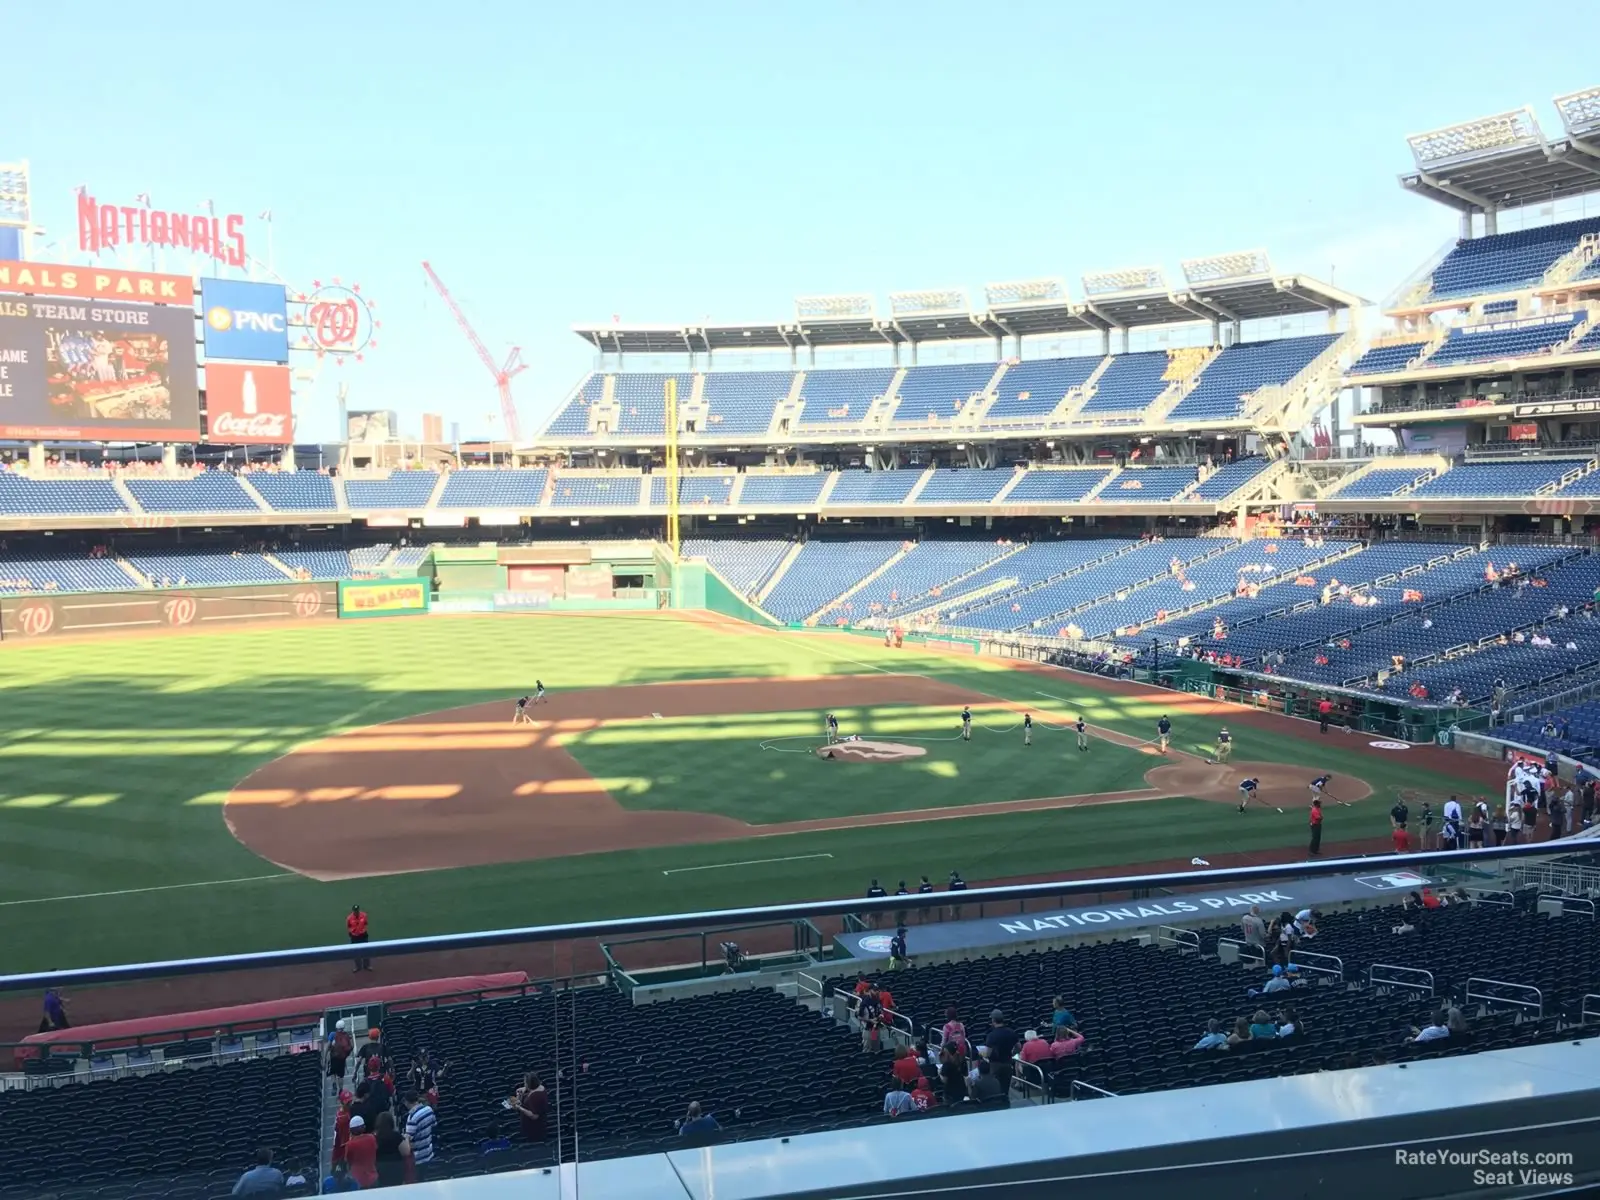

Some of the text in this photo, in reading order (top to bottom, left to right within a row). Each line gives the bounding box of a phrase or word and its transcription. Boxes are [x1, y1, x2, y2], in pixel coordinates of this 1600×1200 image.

[78, 193, 245, 266] NATIONALS
[95, 274, 177, 297] PARK
[32, 304, 87, 320] TEAM
[91, 308, 149, 325] STORE
[234, 310, 285, 332] PNC
[999, 890, 1294, 934] NATIONALS PARK
